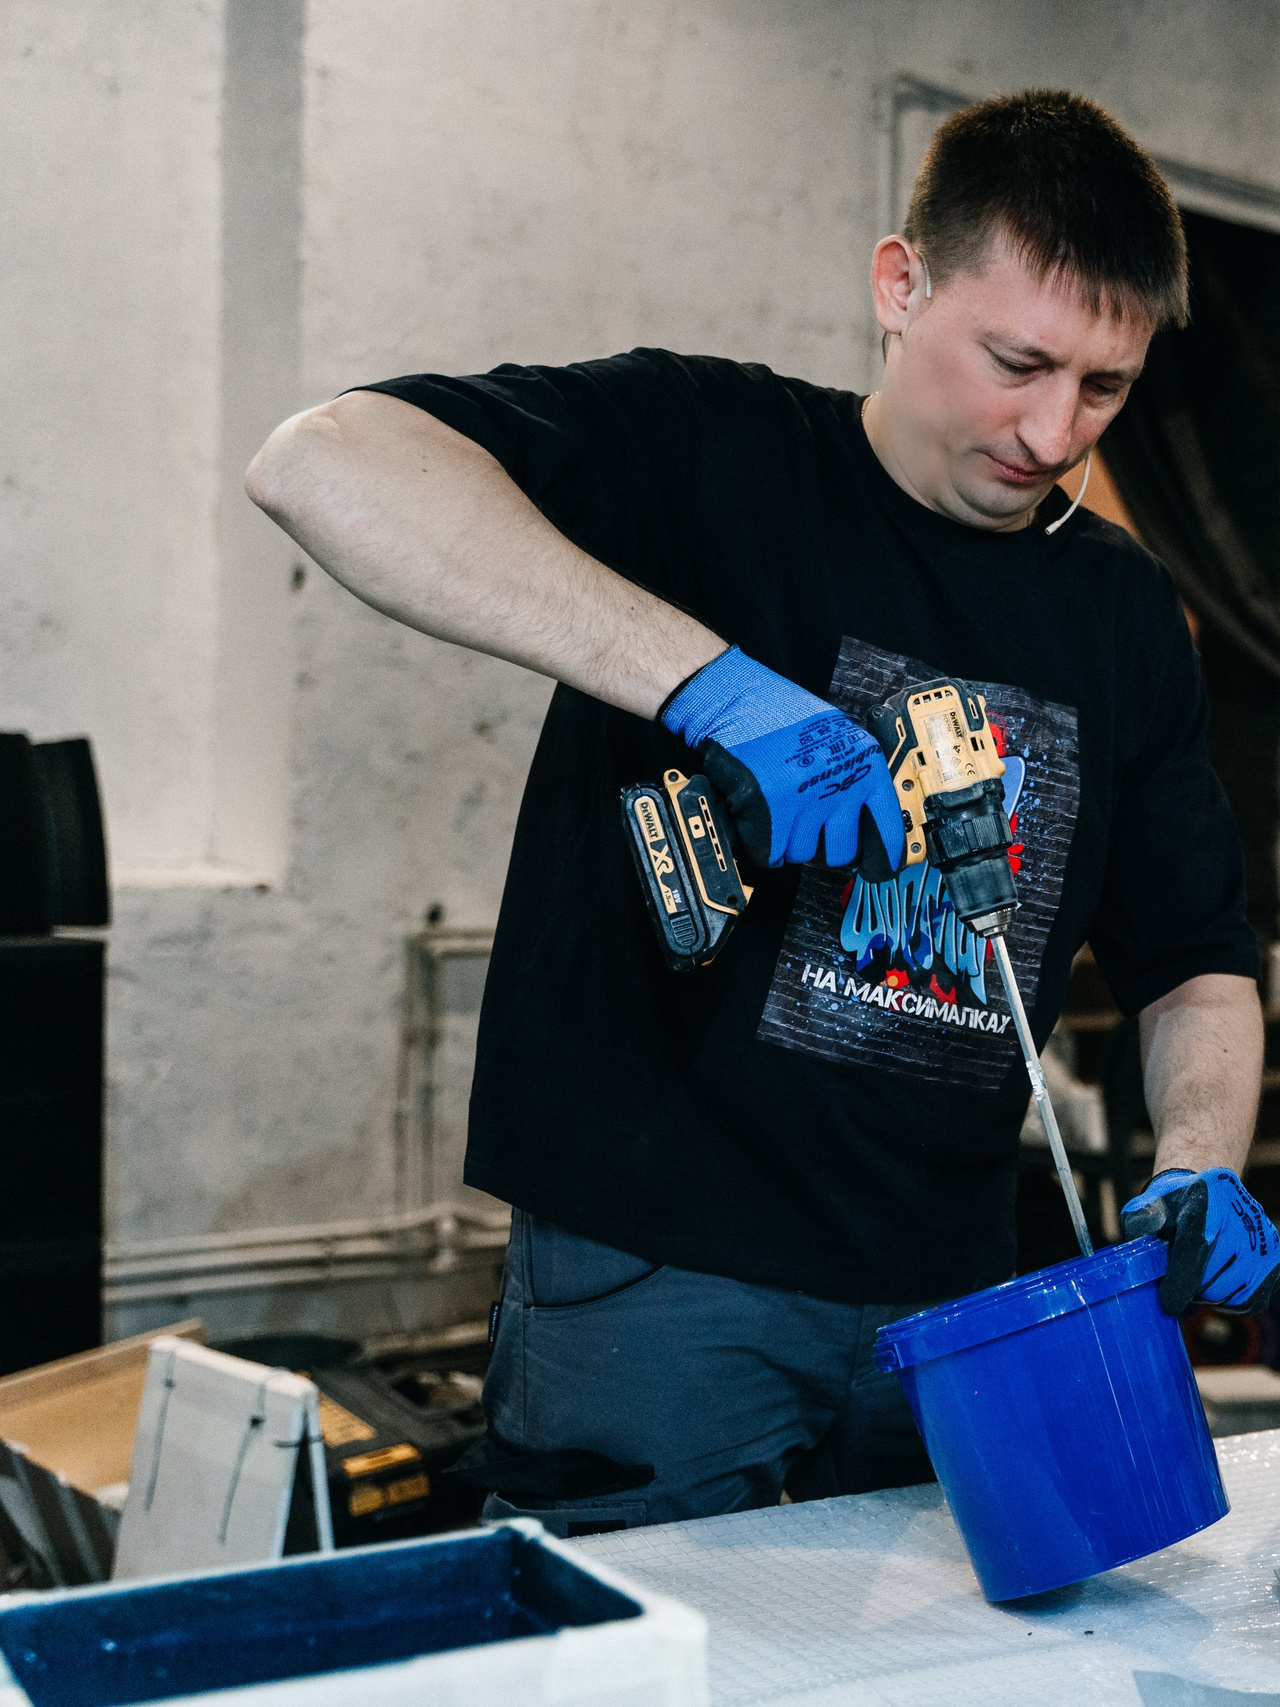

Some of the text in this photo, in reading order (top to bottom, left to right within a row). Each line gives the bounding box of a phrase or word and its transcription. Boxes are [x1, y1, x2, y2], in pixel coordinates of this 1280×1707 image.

[650, 843, 675, 876] XR
[672, 888, 682, 904] 18V
[800, 963, 1012, 1034] НА МАКСИМАЛКАХ
